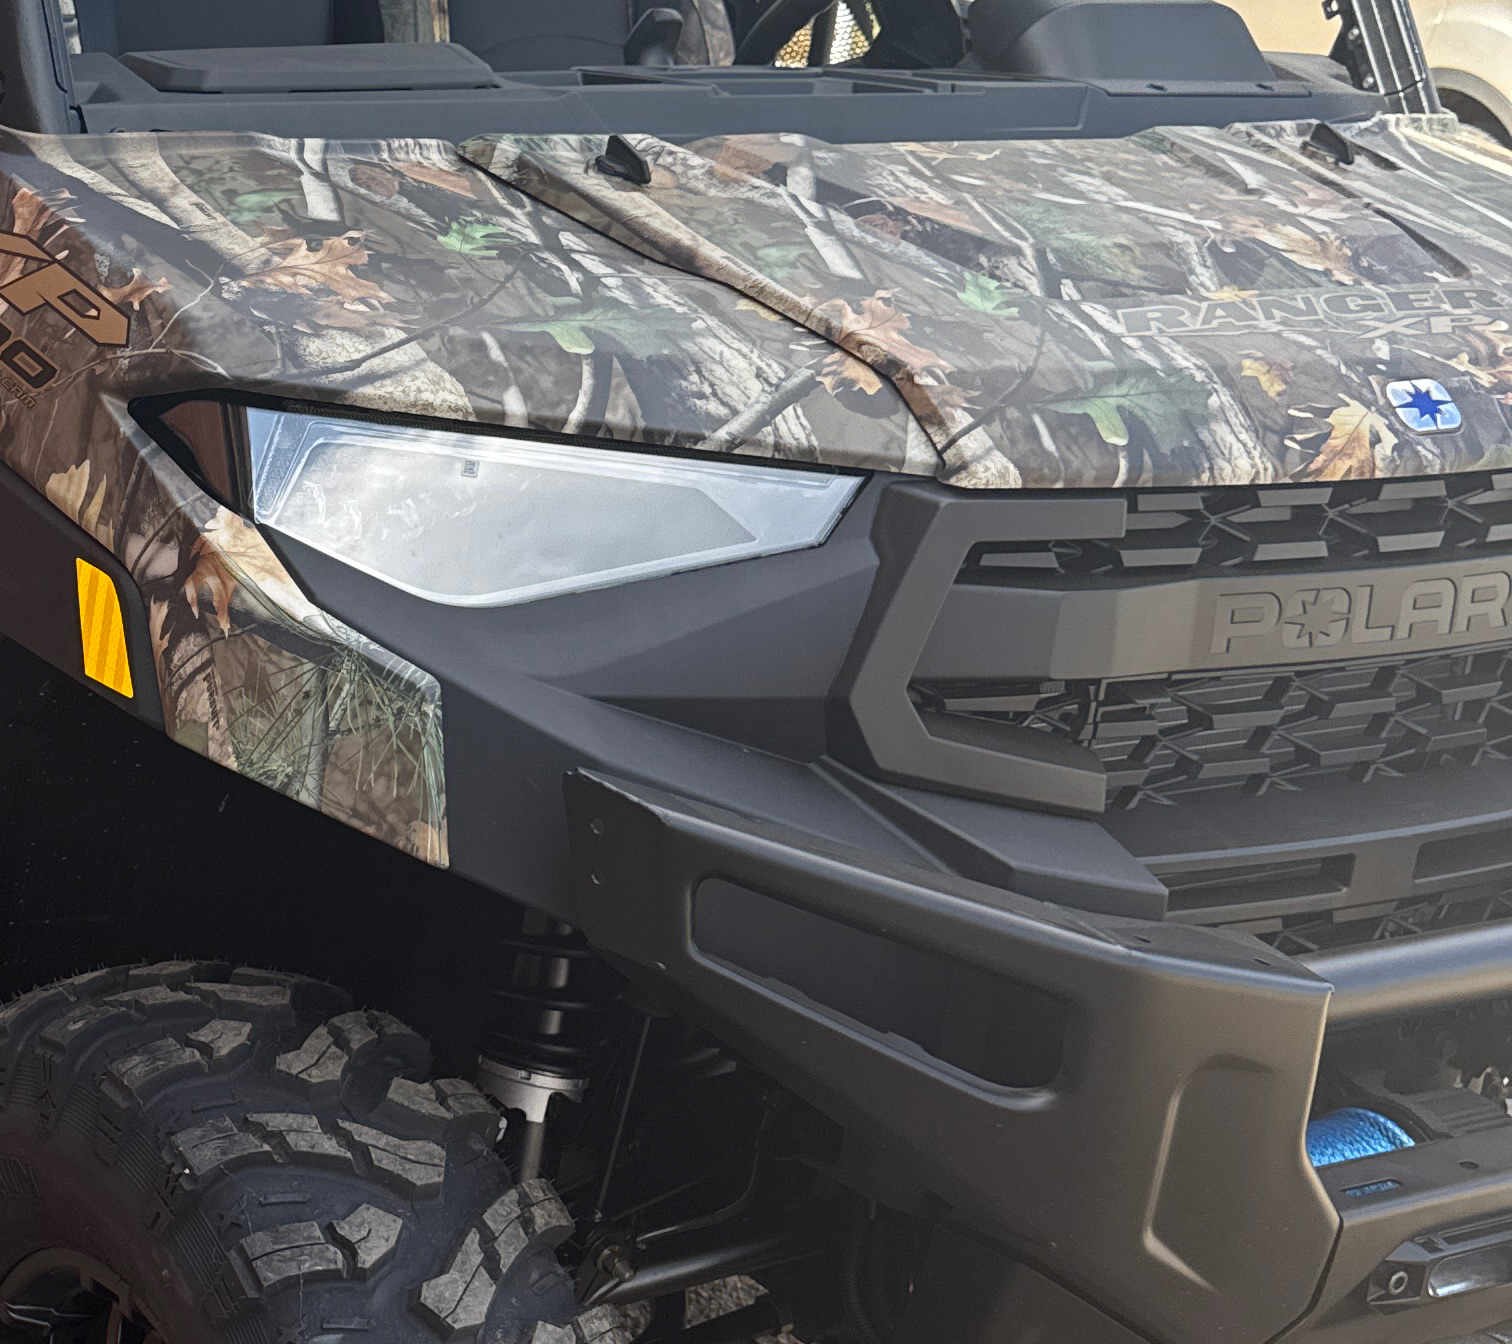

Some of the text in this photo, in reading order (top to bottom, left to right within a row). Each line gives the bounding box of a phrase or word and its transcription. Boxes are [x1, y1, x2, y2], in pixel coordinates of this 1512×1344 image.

[1117, 286, 1510, 336] RANGER
[1355, 314, 1493, 340] XP
[1, 376, 36, 409] CAM
